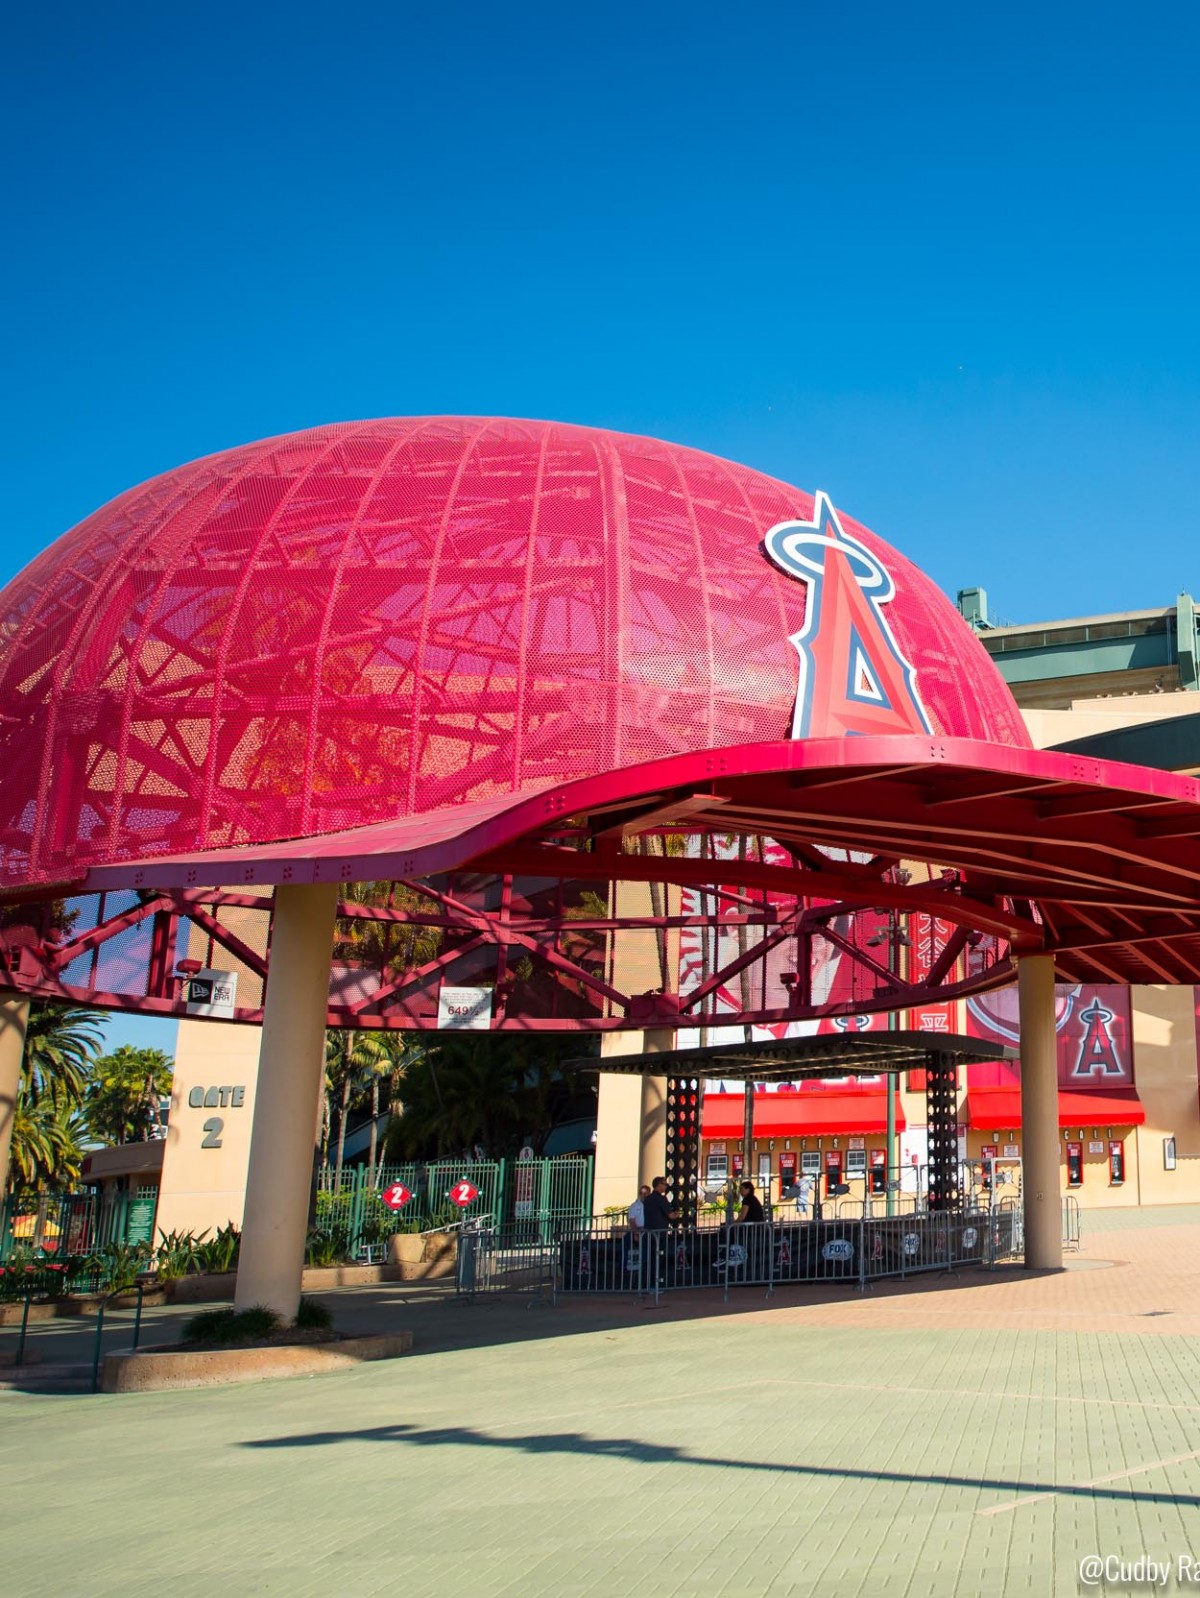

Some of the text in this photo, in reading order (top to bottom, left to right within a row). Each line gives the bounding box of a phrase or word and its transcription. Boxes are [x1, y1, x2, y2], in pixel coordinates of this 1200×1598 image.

[215, 986, 230, 994] NEW
[188, 1085, 246, 1109] GATE
[200, 1116, 225, 1149] 2
[391, 1187, 403, 1204] 2
[459, 1184, 470, 1201] 2
[829, 1244, 847, 1253] FOX
